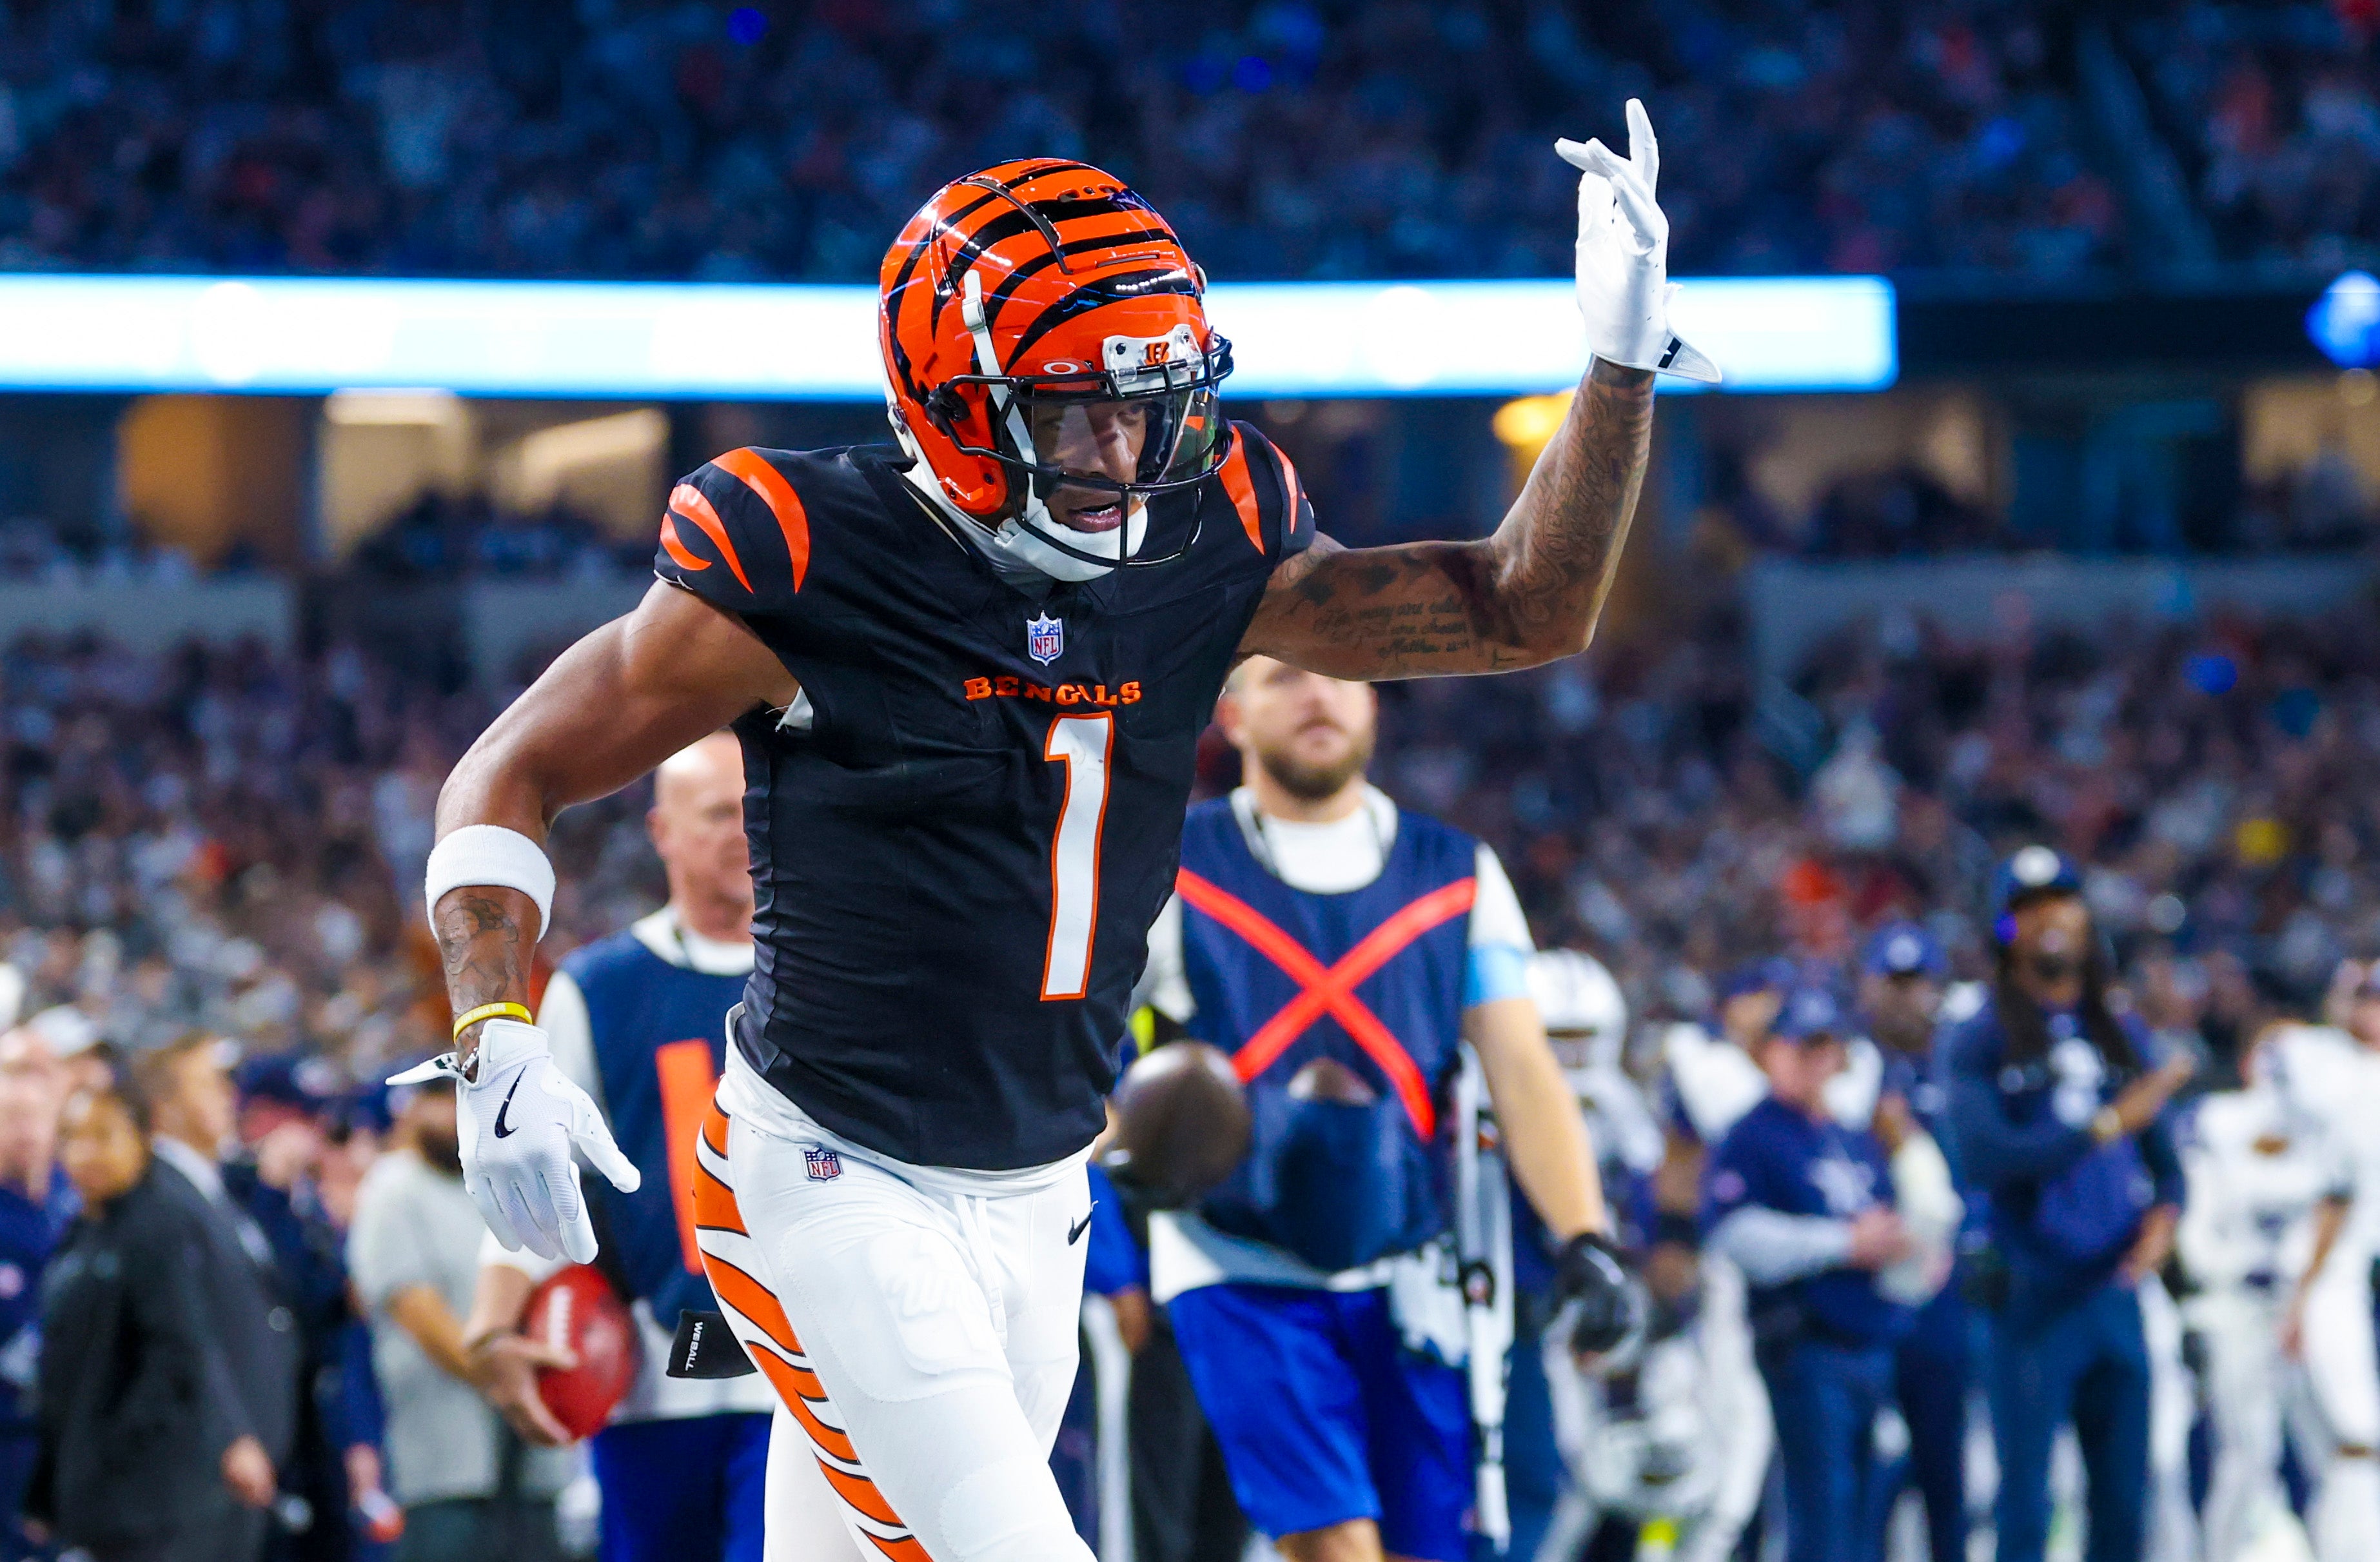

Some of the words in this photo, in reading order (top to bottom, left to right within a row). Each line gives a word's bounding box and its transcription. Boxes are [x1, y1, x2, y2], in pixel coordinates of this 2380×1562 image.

[1034, 636, 1057, 656] NFL
[963, 676, 1143, 706] BENGALS
[1039, 710, 1114, 1002] 1
[810, 1162, 838, 1177] NFL
[692, 1321, 703, 1341] WE
[685, 1341, 699, 1371] BALL
